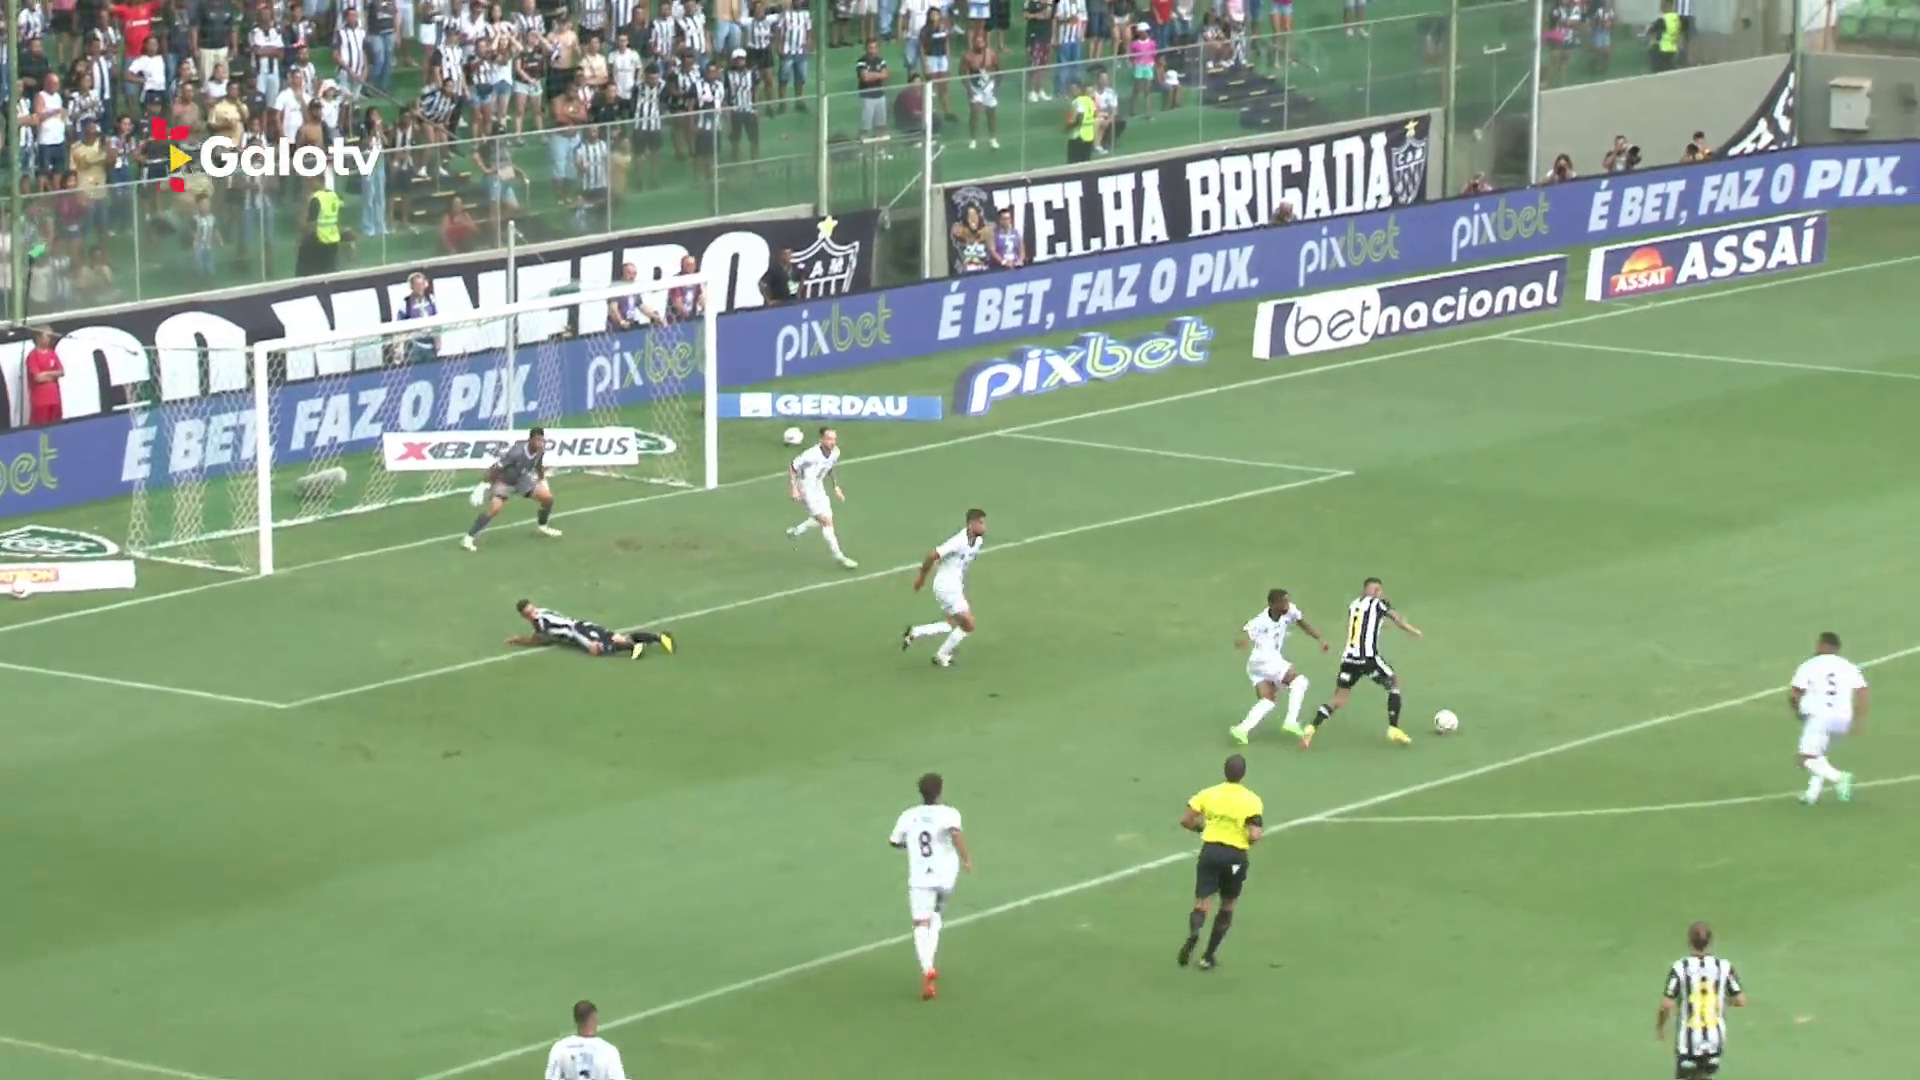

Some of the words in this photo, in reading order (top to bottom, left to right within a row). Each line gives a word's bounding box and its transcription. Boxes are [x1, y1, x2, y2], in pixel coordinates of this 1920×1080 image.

[992, 168, 1169, 262] VELHA
[1186, 132, 1393, 237] BRIGADA
[1451, 191, 1550, 262] pixbet
[1588, 180, 1613, 233] É
[1618, 178, 1687, 228] BET,
[1698, 167, 1764, 216] FAZ
[1770, 163, 1796, 205] O
[1804, 156, 1909, 199] PIX.
[1298, 214, 1400, 287] pixbet
[937, 281, 966, 340] É
[973, 278, 1055, 334] BET,
[1066, 263, 1142, 318] FAZ
[1149, 258, 1178, 304] O
[1186, 245, 1259, 298] PIX.
[775, 294, 892, 376] pixbet
[968, 319, 1211, 415] pixbet
[121, 413, 157, 482] É
[290, 386, 388, 450] FAZ
[399, 379, 435, 432] O
[446, 364, 539, 431] PIX.
[775, 393, 908, 417] GERDAU
[919, 830, 933, 858] 8
